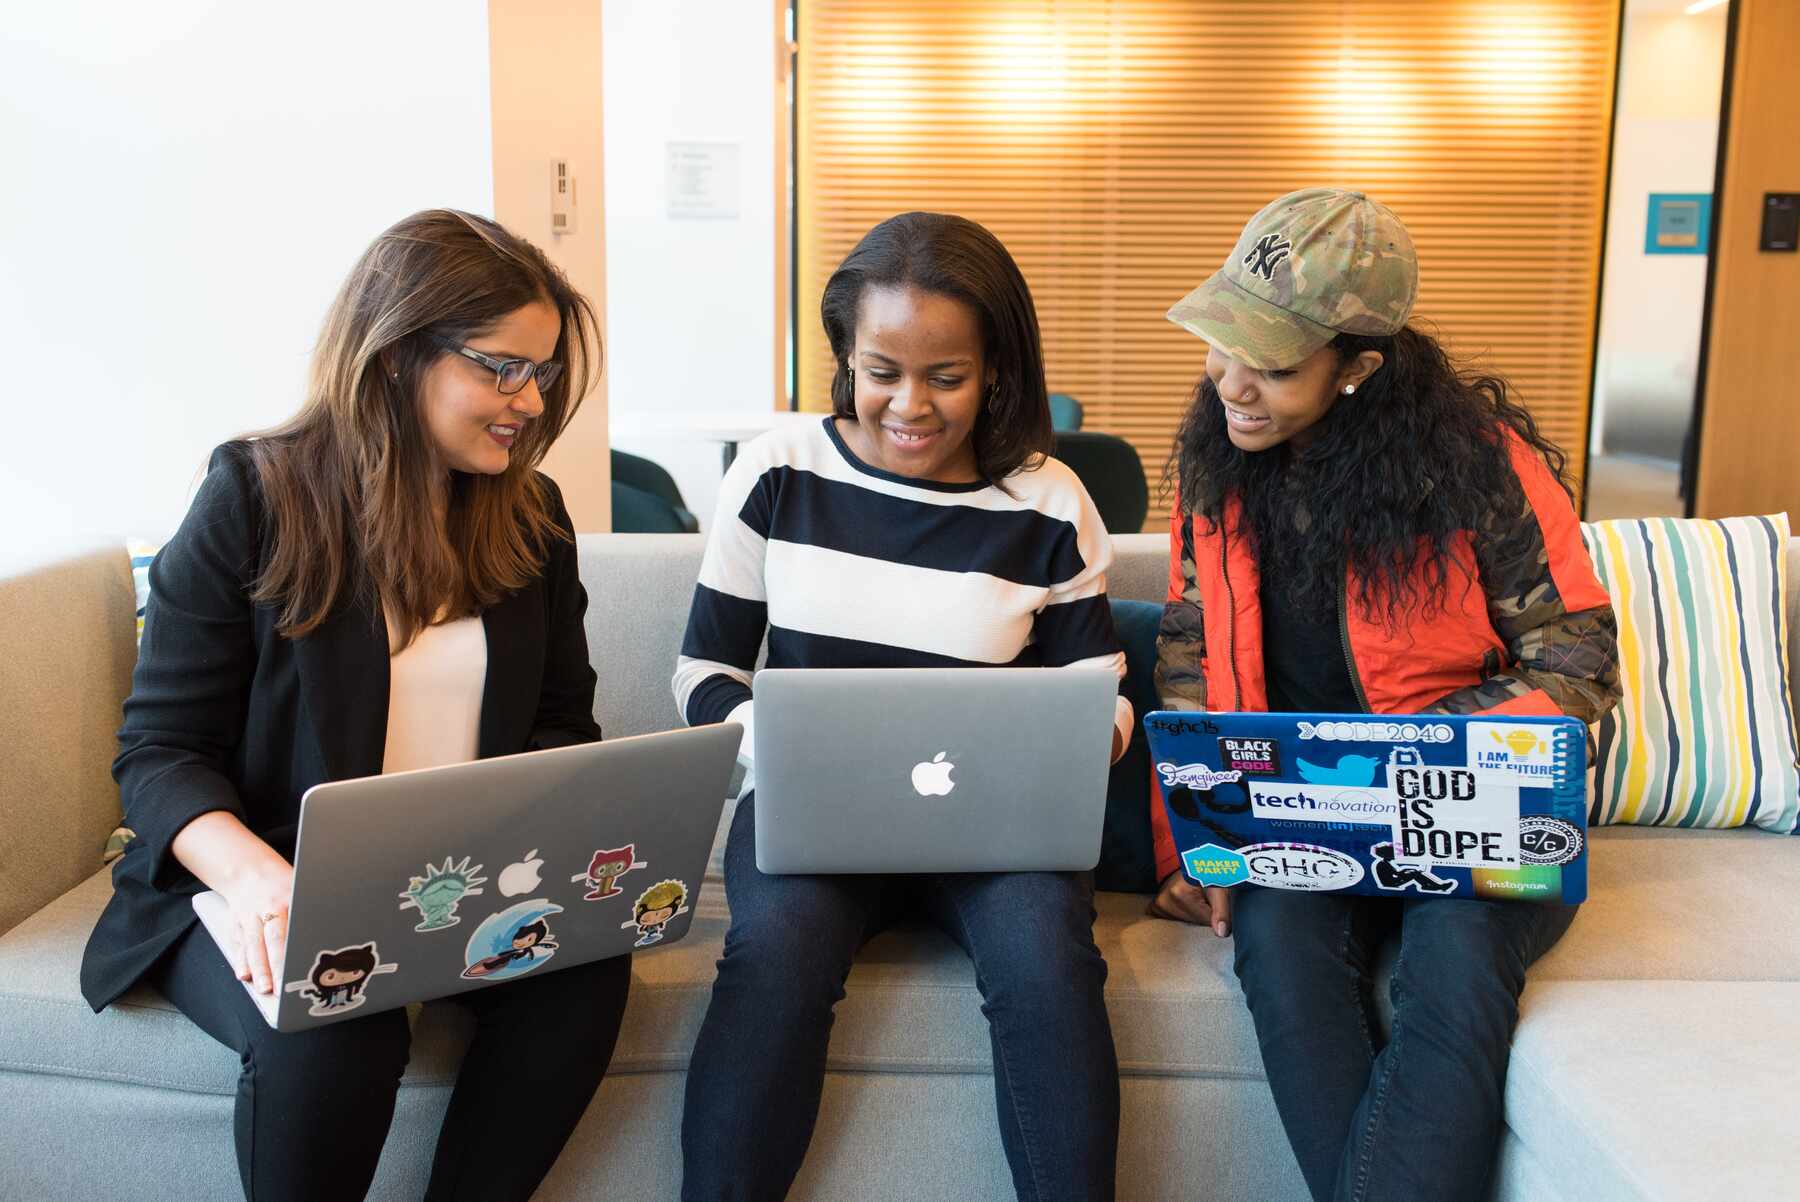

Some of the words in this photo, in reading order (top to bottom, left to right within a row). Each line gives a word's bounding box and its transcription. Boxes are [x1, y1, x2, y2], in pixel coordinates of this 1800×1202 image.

[1317, 722, 1451, 742] CODE2040
[1226, 740, 1273, 751] BLACK
[1231, 751, 1271, 761] GIRLS
[1478, 752, 1482, 761] I
[1487, 752, 1508, 762] AM
[1231, 761, 1275, 770] CODE
[1159, 764, 1241, 788] Femgineer
[1396, 769, 1476, 801] GOD
[1254, 792, 1397, 814] technovation
[1399, 799, 1435, 829] IS
[1401, 828, 1515, 863] DOPE.
[1192, 859, 1241, 868] MAKER
[1195, 867, 1238, 875] PARTY
[1250, 857, 1339, 879] GHC
[1486, 880, 1549, 892] Instagram
